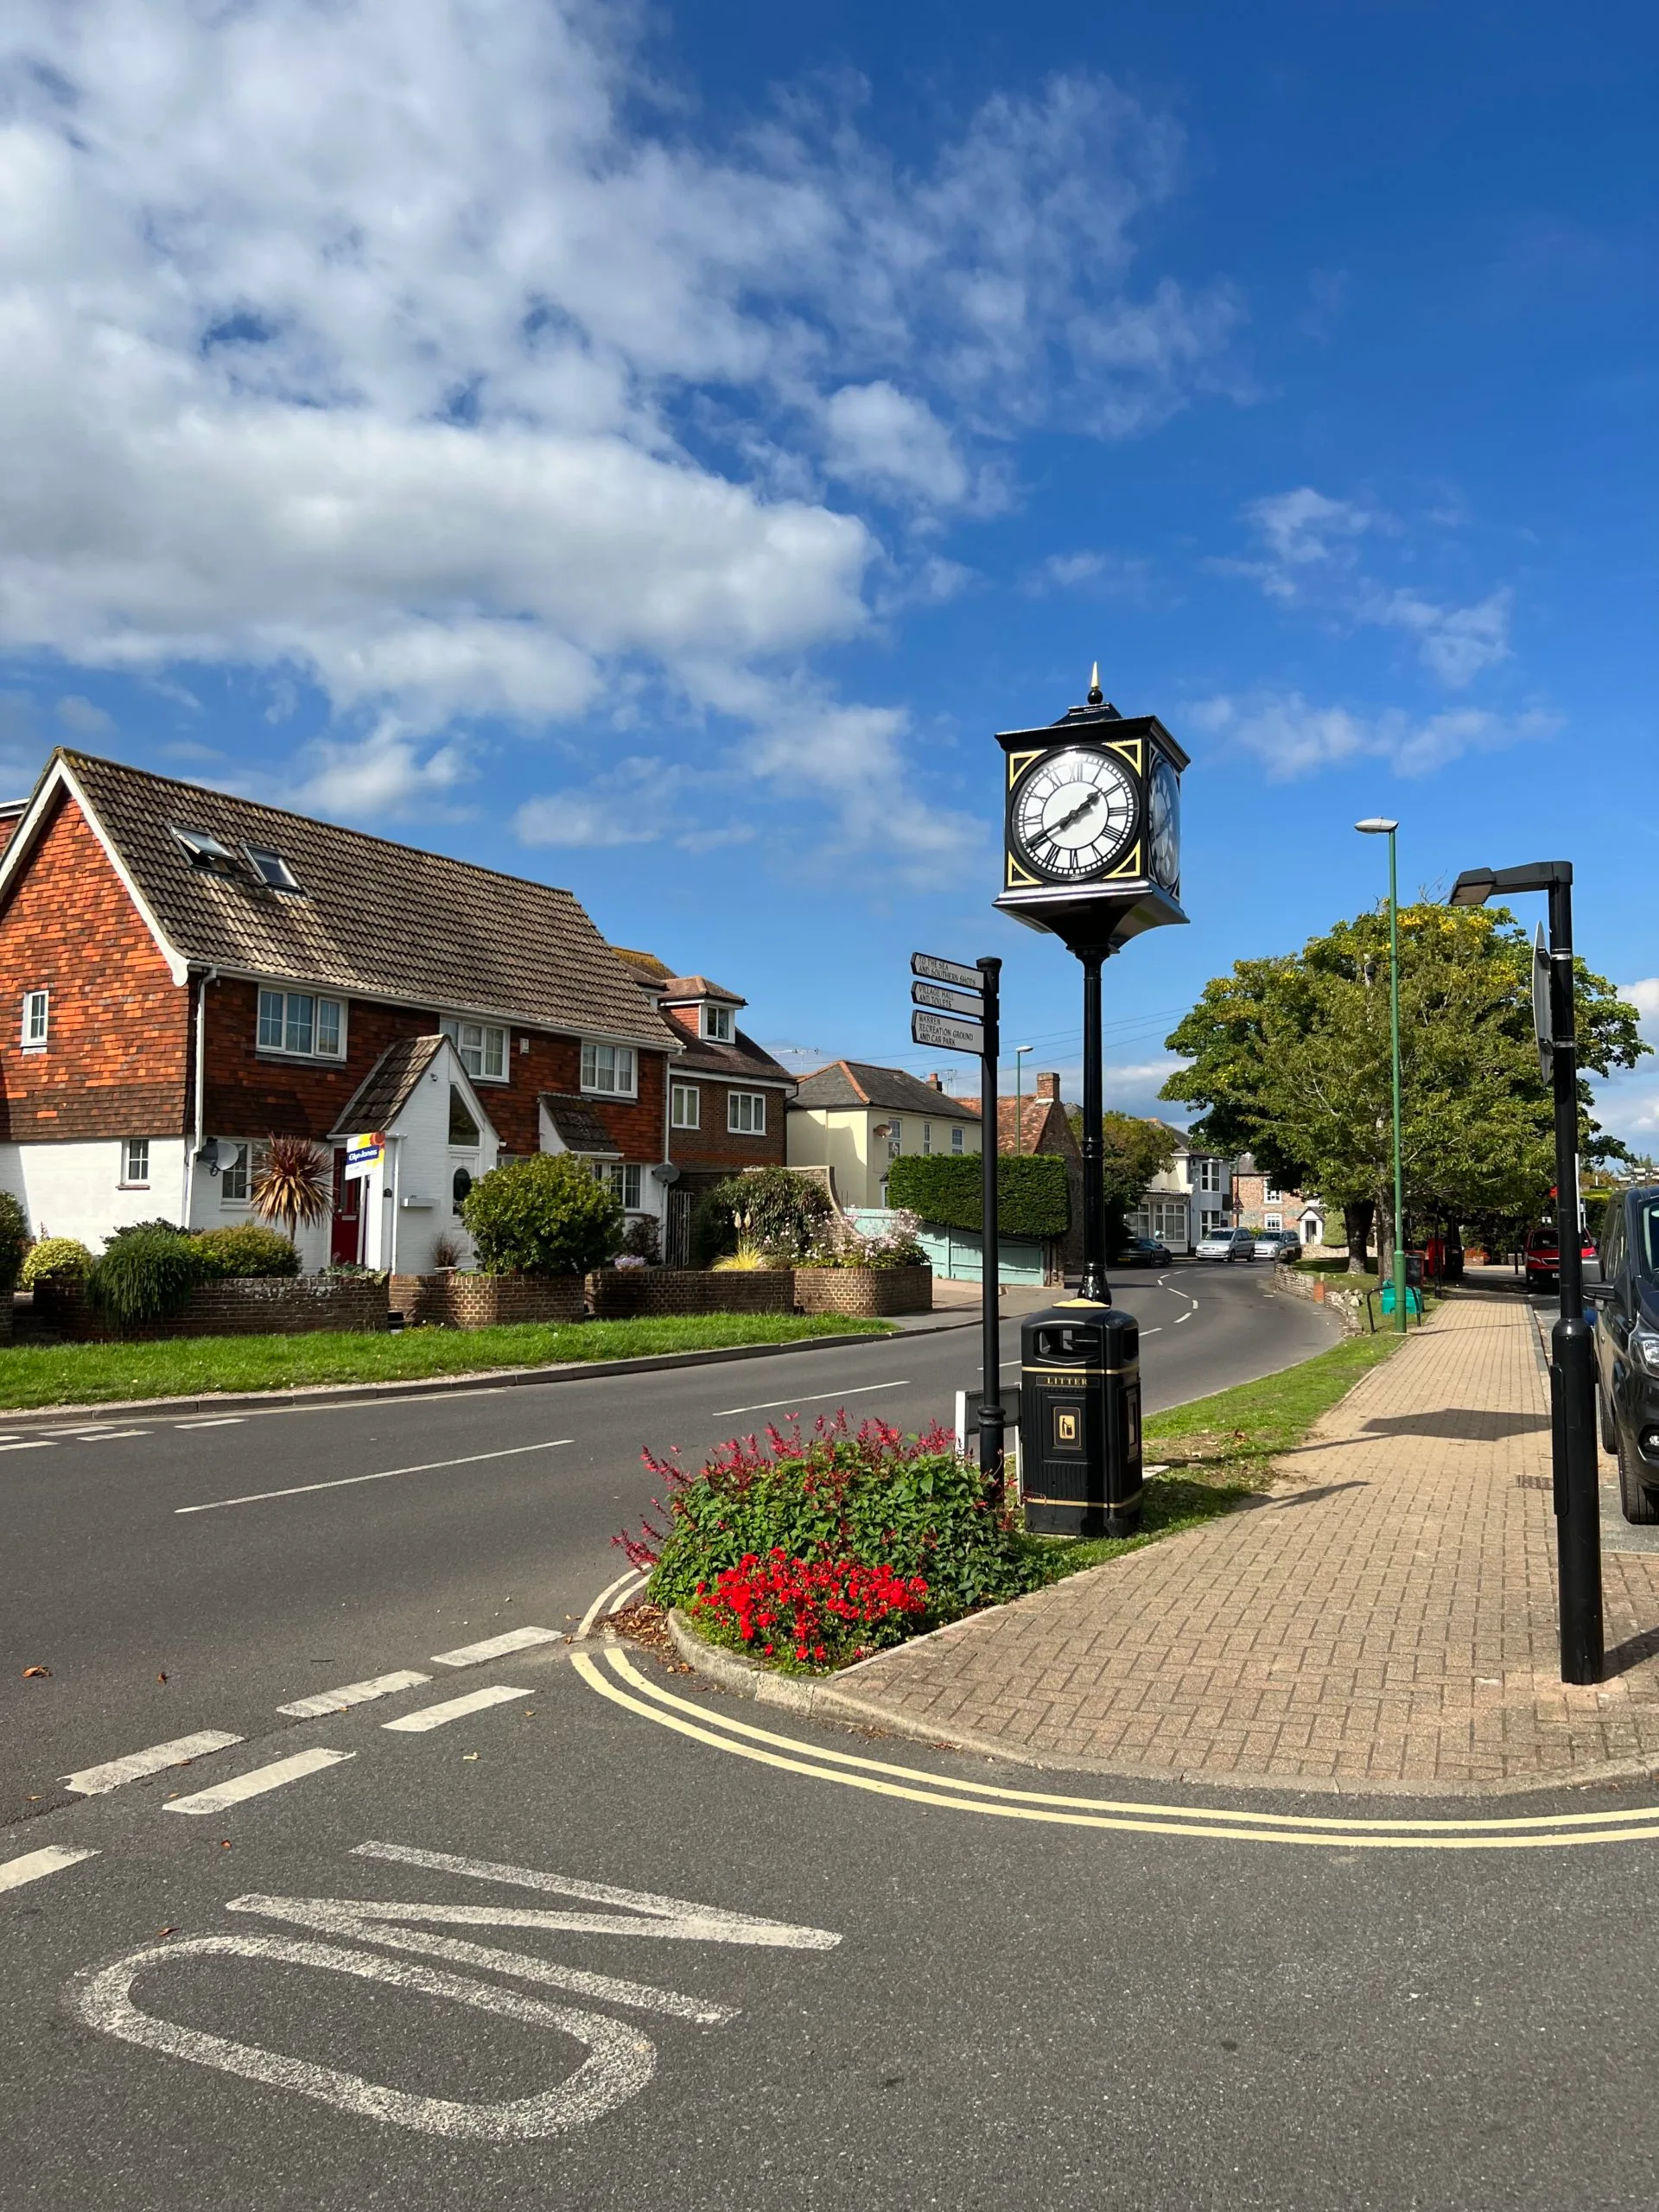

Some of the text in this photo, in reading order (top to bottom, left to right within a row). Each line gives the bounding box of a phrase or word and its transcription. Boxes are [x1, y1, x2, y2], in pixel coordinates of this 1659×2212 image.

[918, 956, 949, 971] TO THE SEA
[918, 965, 976, 986] AND SOUTHERN SHOPS
[918, 985, 954, 1001] VILLAGE HALL
[918, 994, 952, 1008] AND TOILETS
[918, 1014, 941, 1026] WARREN
[918, 1023, 974, 1041] RECREATION GROUND
[918, 1033, 956, 1046] AND CAR PARK
[1046, 1376, 1088, 1386] LITTER
